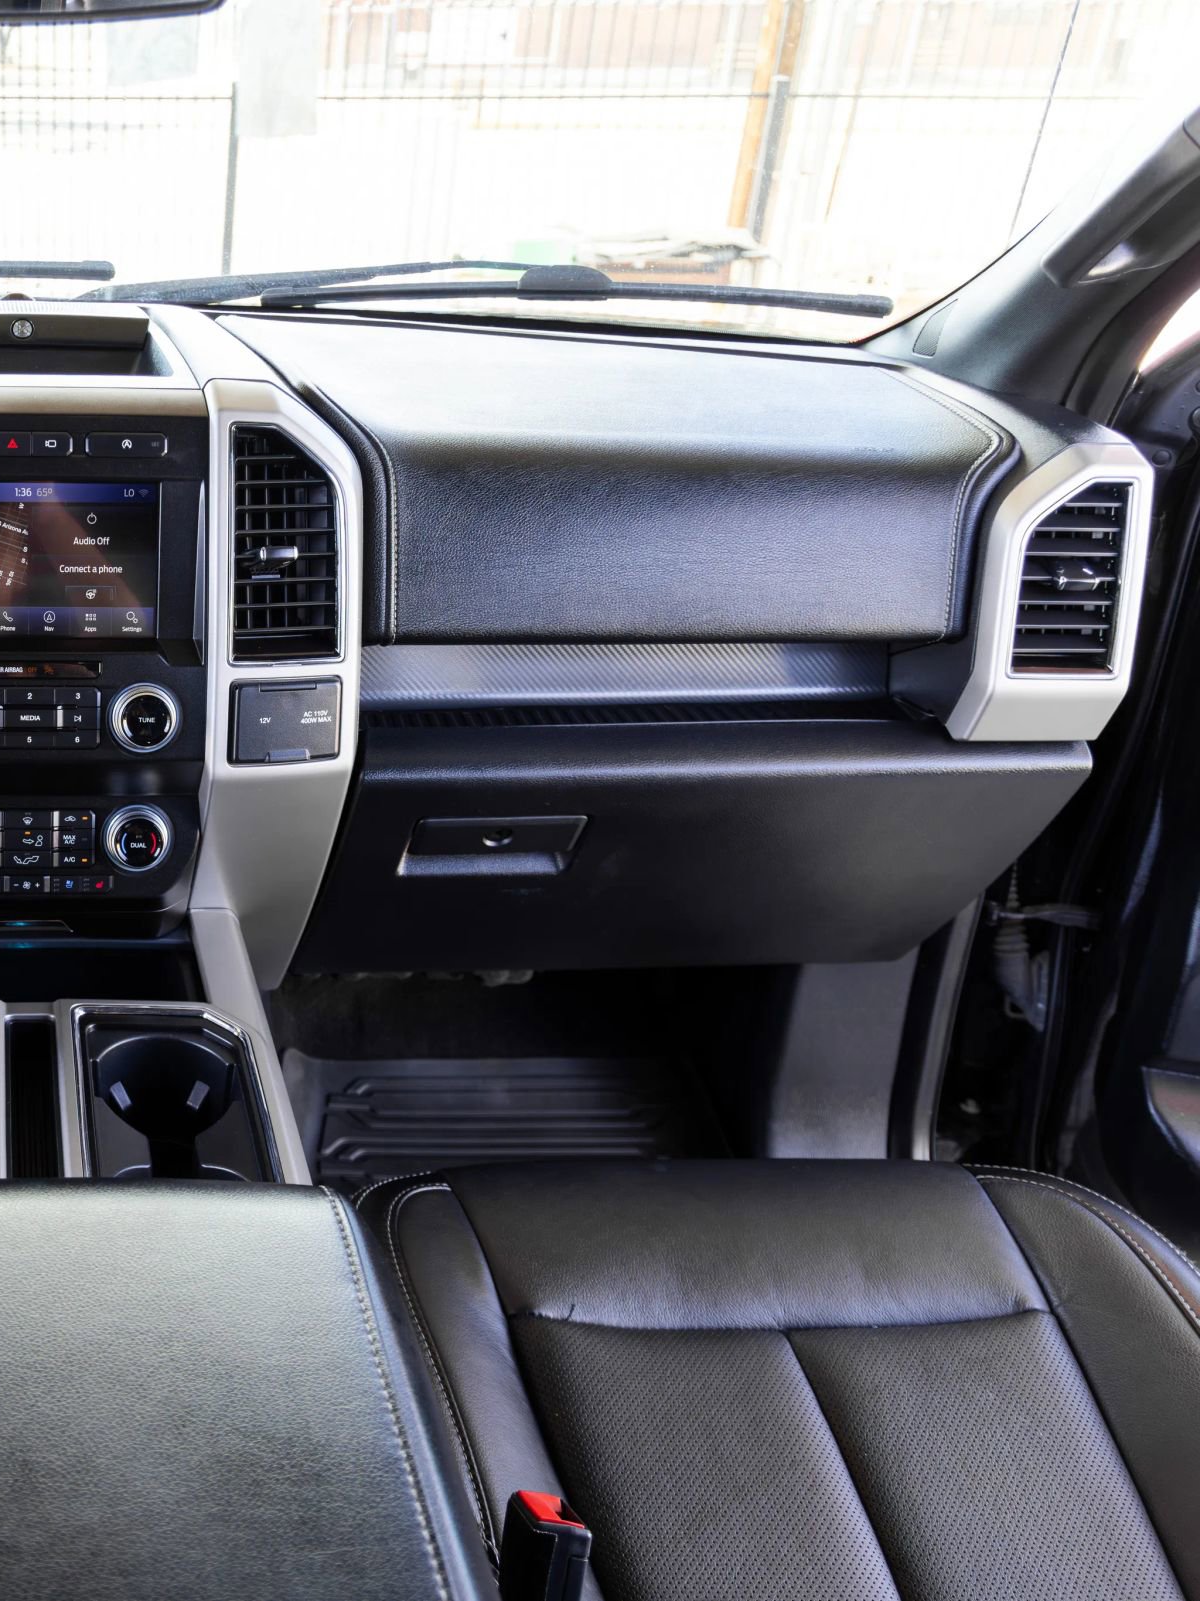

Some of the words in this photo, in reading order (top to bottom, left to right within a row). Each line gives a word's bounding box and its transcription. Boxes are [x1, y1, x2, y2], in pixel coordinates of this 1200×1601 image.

[15, 487, 32, 497] 1:36
[124, 488, 135, 497] LO
[73, 537, 96, 545] Audio
[97, 537, 110, 545] Off
[59, 565, 90, 573] Connect
[98, 565, 123, 574] phone
